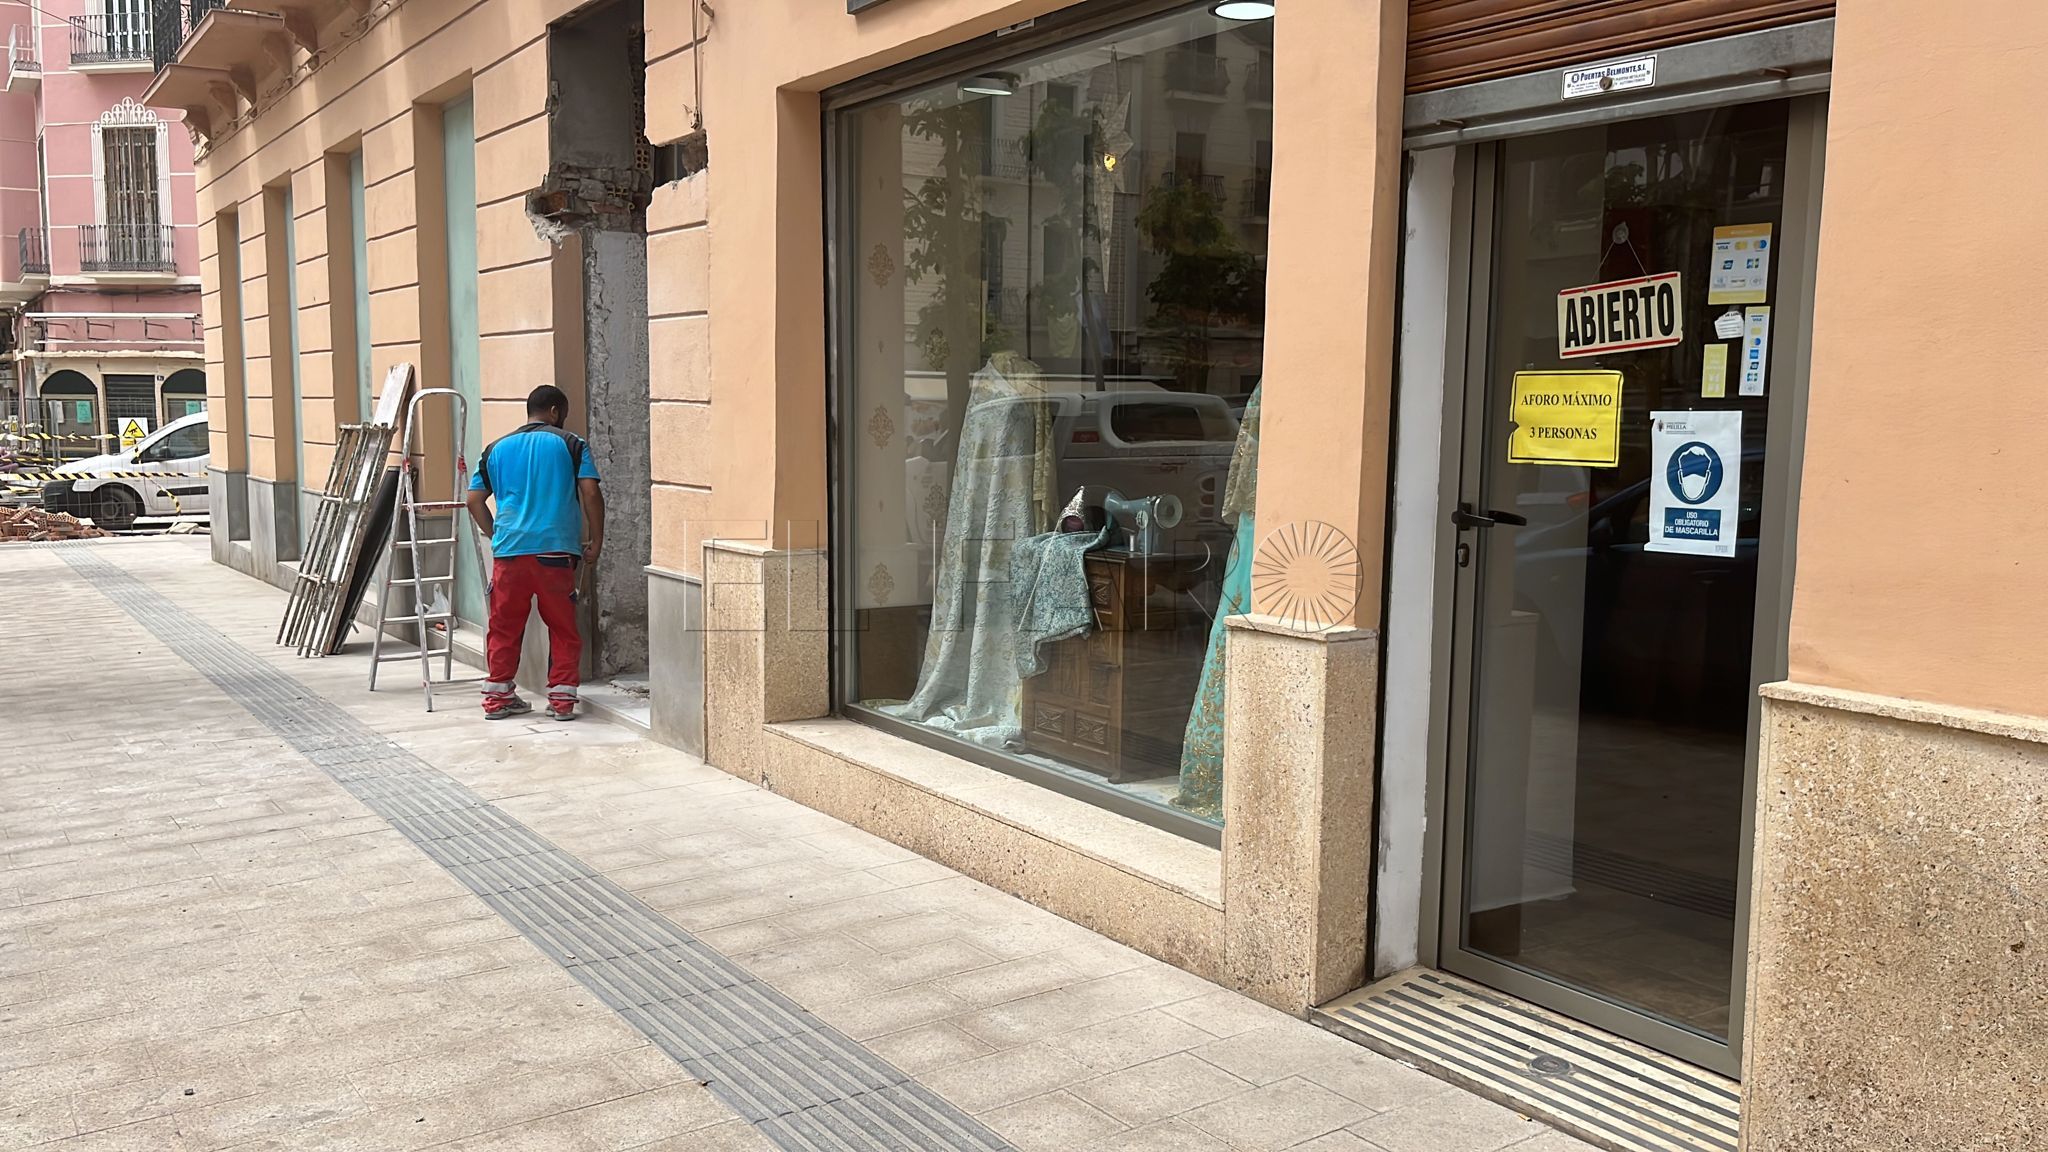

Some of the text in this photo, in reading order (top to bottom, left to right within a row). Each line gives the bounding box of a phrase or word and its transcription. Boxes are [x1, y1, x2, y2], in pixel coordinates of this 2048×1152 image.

[1580, 71, 1605, 81] PUERTAS
[1565, 283, 1674, 348] ABIERTO
[1521, 391, 1612, 406] AFORO MÁXIMO
[1530, 427, 1597, 439] 3 PERSONAS
[1686, 511, 1698, 519] USO
[1674, 519, 1709, 527] OBLIGATORIO
[1664, 526, 1718, 537] DE MASCARILLA
